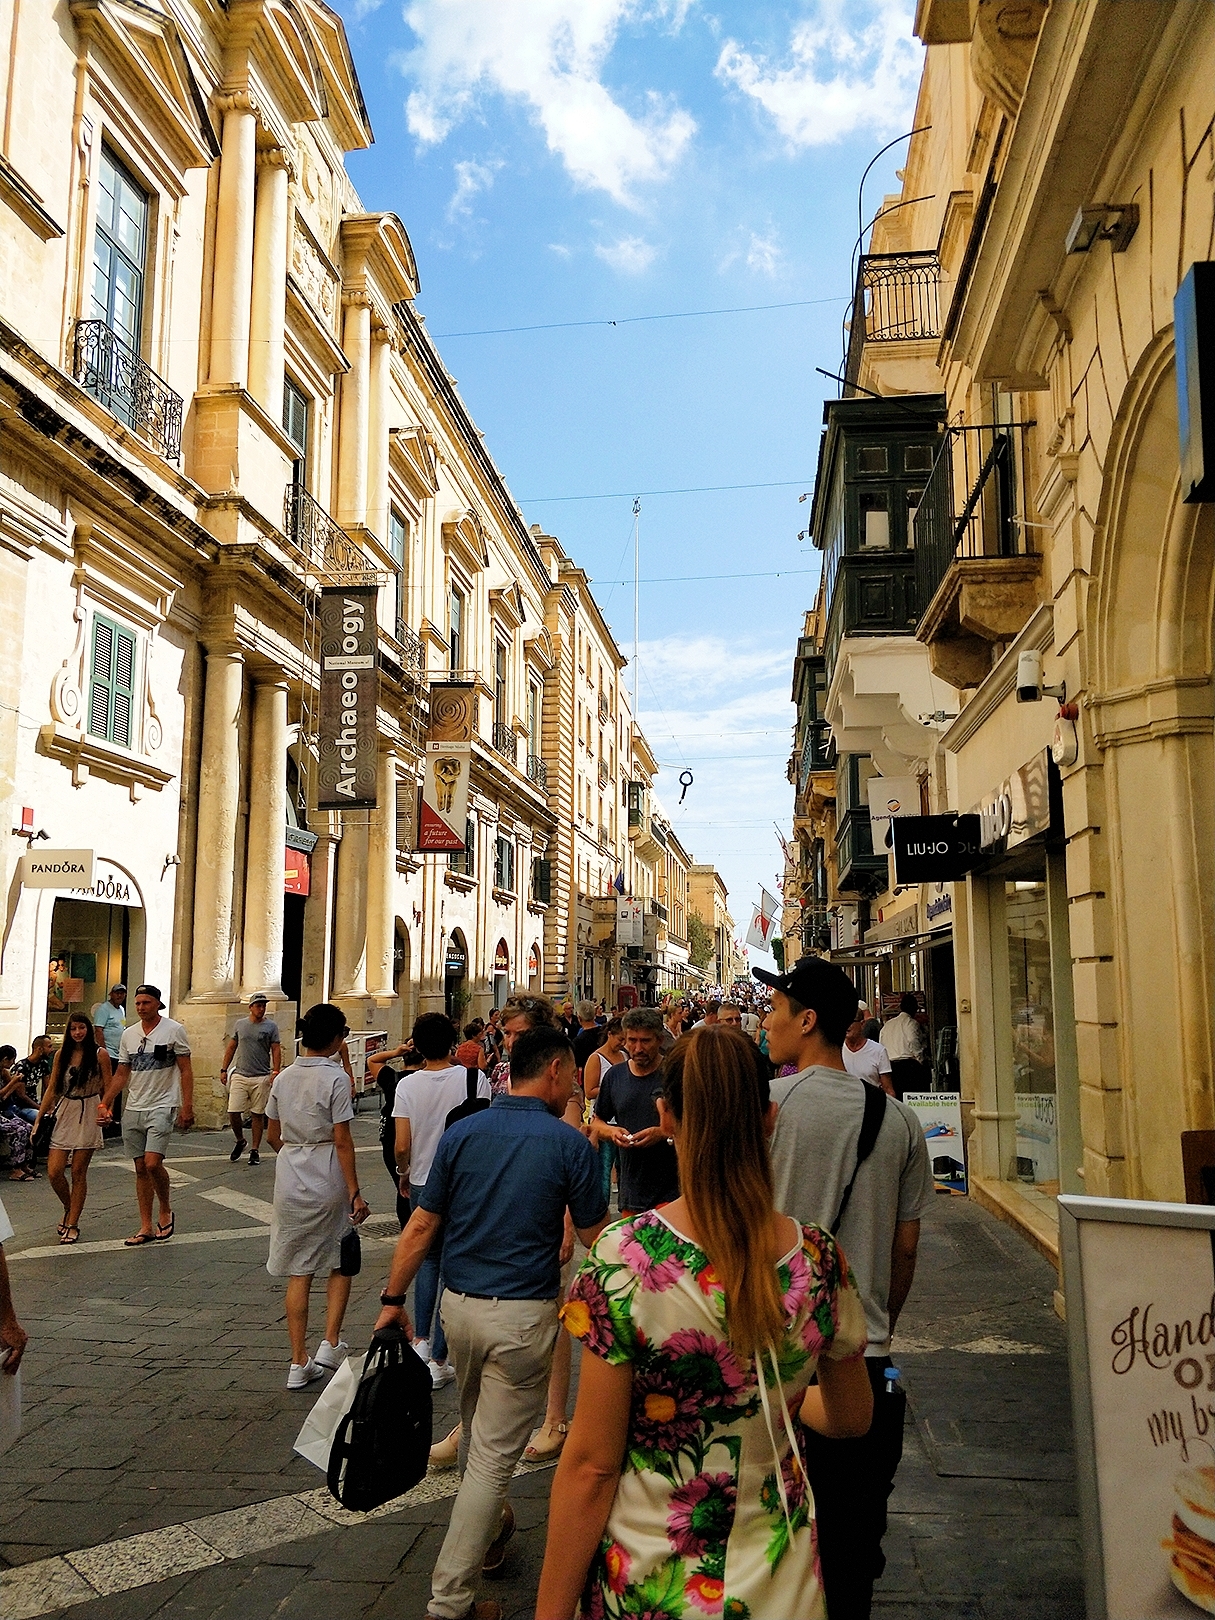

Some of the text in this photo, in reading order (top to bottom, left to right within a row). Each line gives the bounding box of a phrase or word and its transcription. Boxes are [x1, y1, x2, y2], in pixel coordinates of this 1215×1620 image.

[333, 598, 367, 798] Archaeology
[429, 829, 448, 838] future
[1147, 1409, 1189, 1462] my
